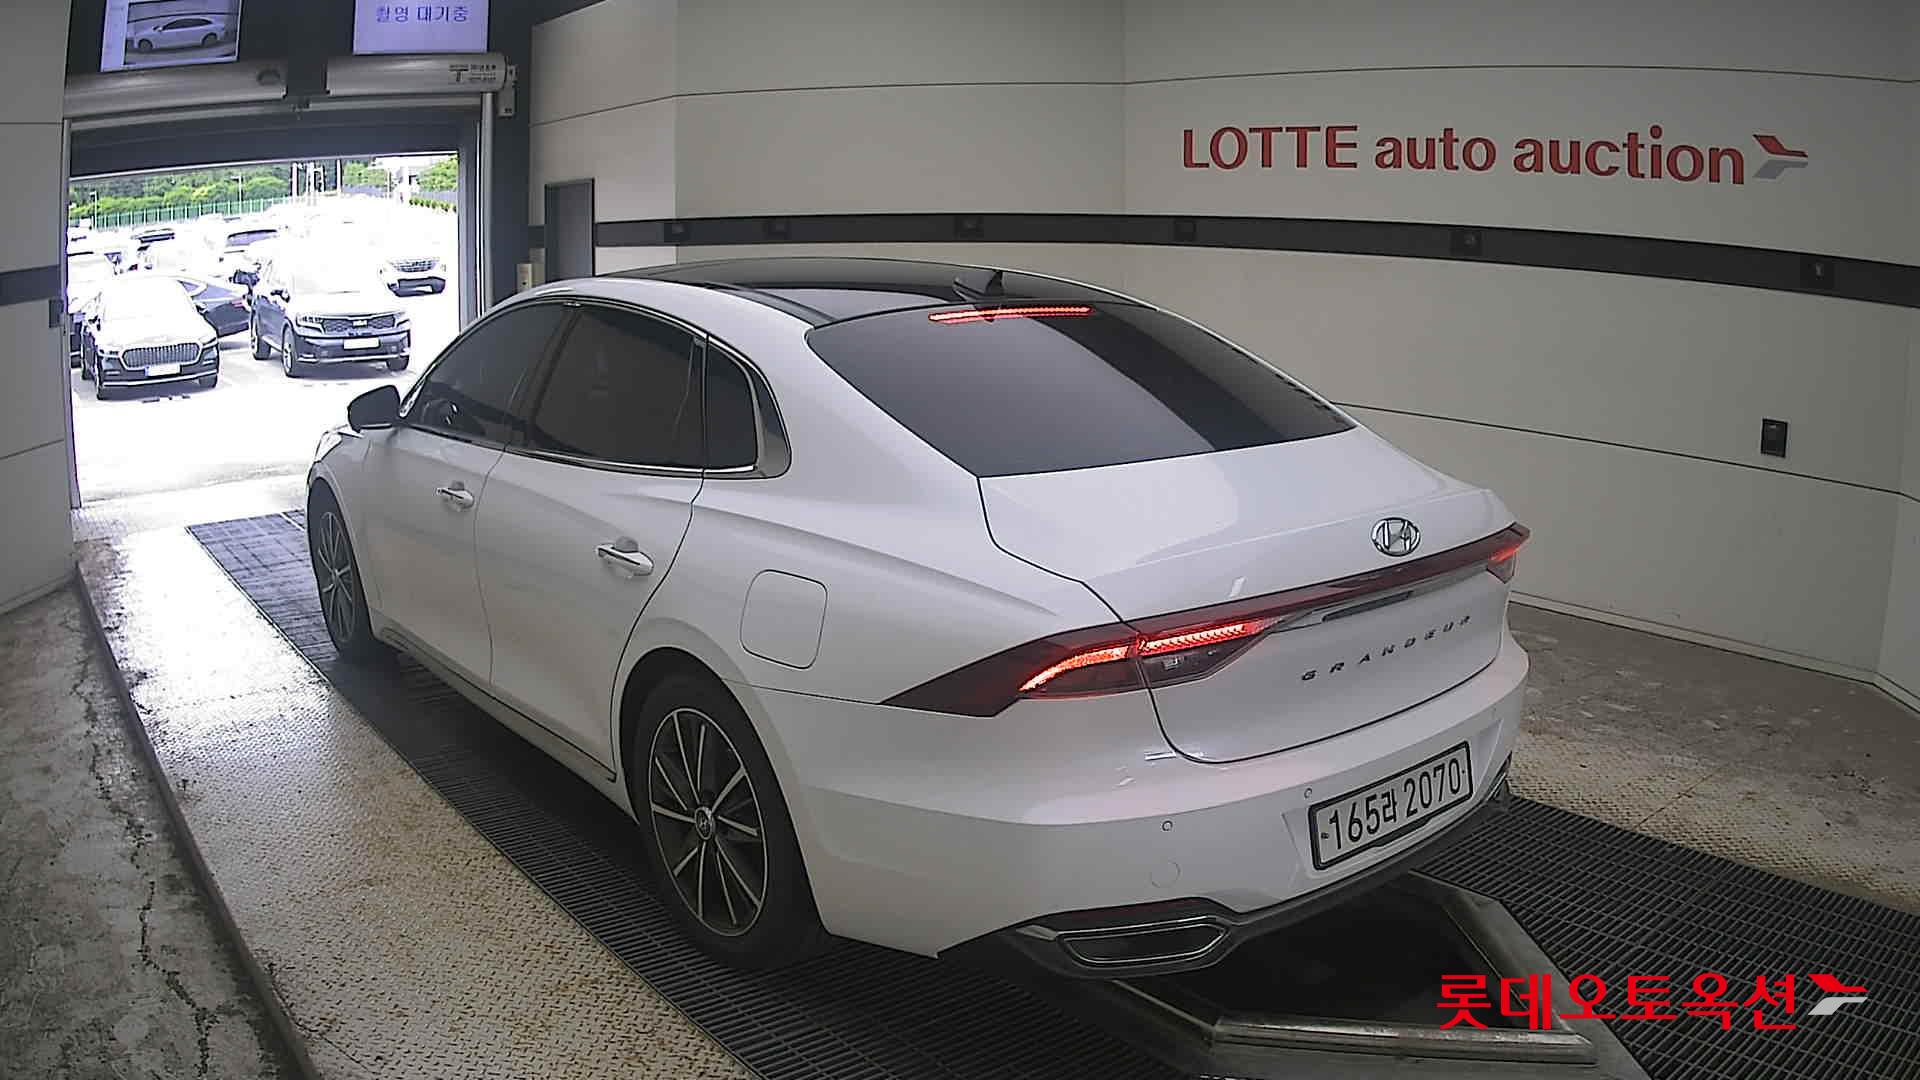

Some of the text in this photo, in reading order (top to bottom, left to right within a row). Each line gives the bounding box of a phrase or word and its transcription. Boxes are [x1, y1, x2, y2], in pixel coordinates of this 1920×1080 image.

[416, 5, 469, 23] 대기중
[1182, 124, 1746, 185] LOTTE auto auction
[1300, 615, 1471, 682] GRANDEUR
[1328, 757, 1462, 850] 165라 2070
